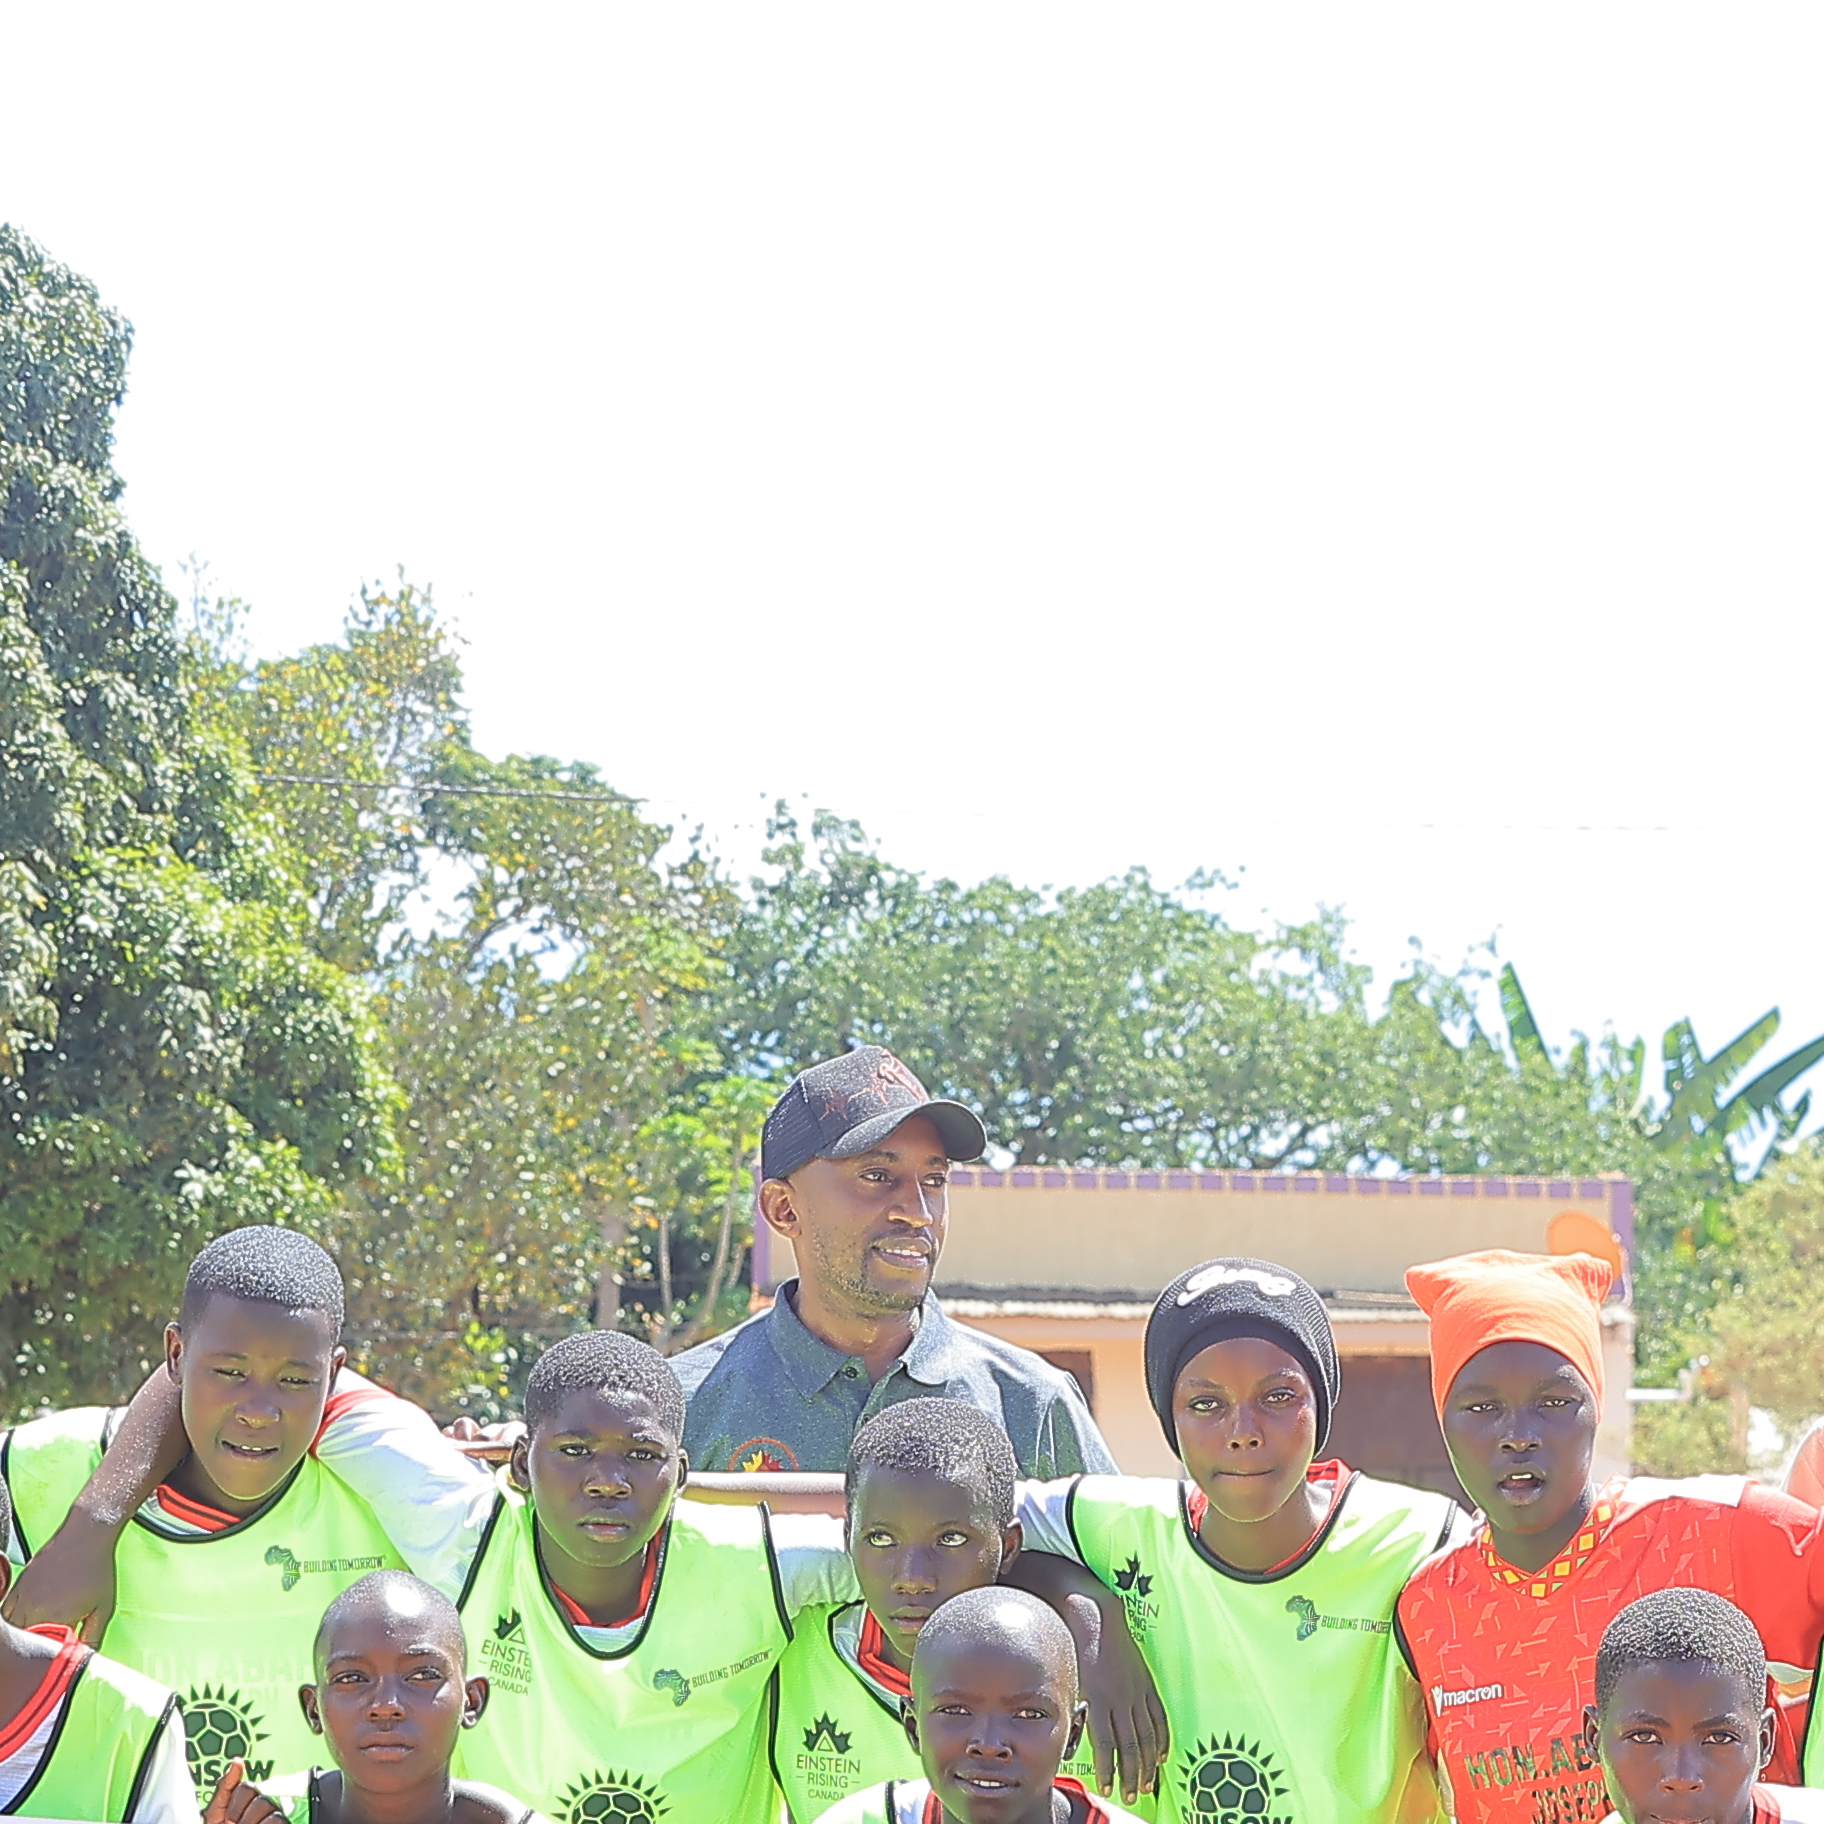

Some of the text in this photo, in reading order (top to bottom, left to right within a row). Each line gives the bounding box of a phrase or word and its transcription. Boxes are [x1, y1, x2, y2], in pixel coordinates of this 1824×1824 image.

[303, 1556, 383, 1573] BUILDING TOMORROW
[1321, 1615, 1358, 1630] BUILDING
[481, 1639, 532, 1668] EINSTE
[489, 1660, 532, 1683] RISING
[692, 1650, 770, 1688] BUILDING TOMORROW
[488, 1676, 529, 1696] CANADA
[1444, 1683, 1503, 1706] macron
[796, 1754, 860, 1774] EINSTEIN
[1464, 1733, 1593, 1789] HON.AB
[807, 1772, 848, 1788] RISING
[808, 1789, 845, 1801] CANADA
